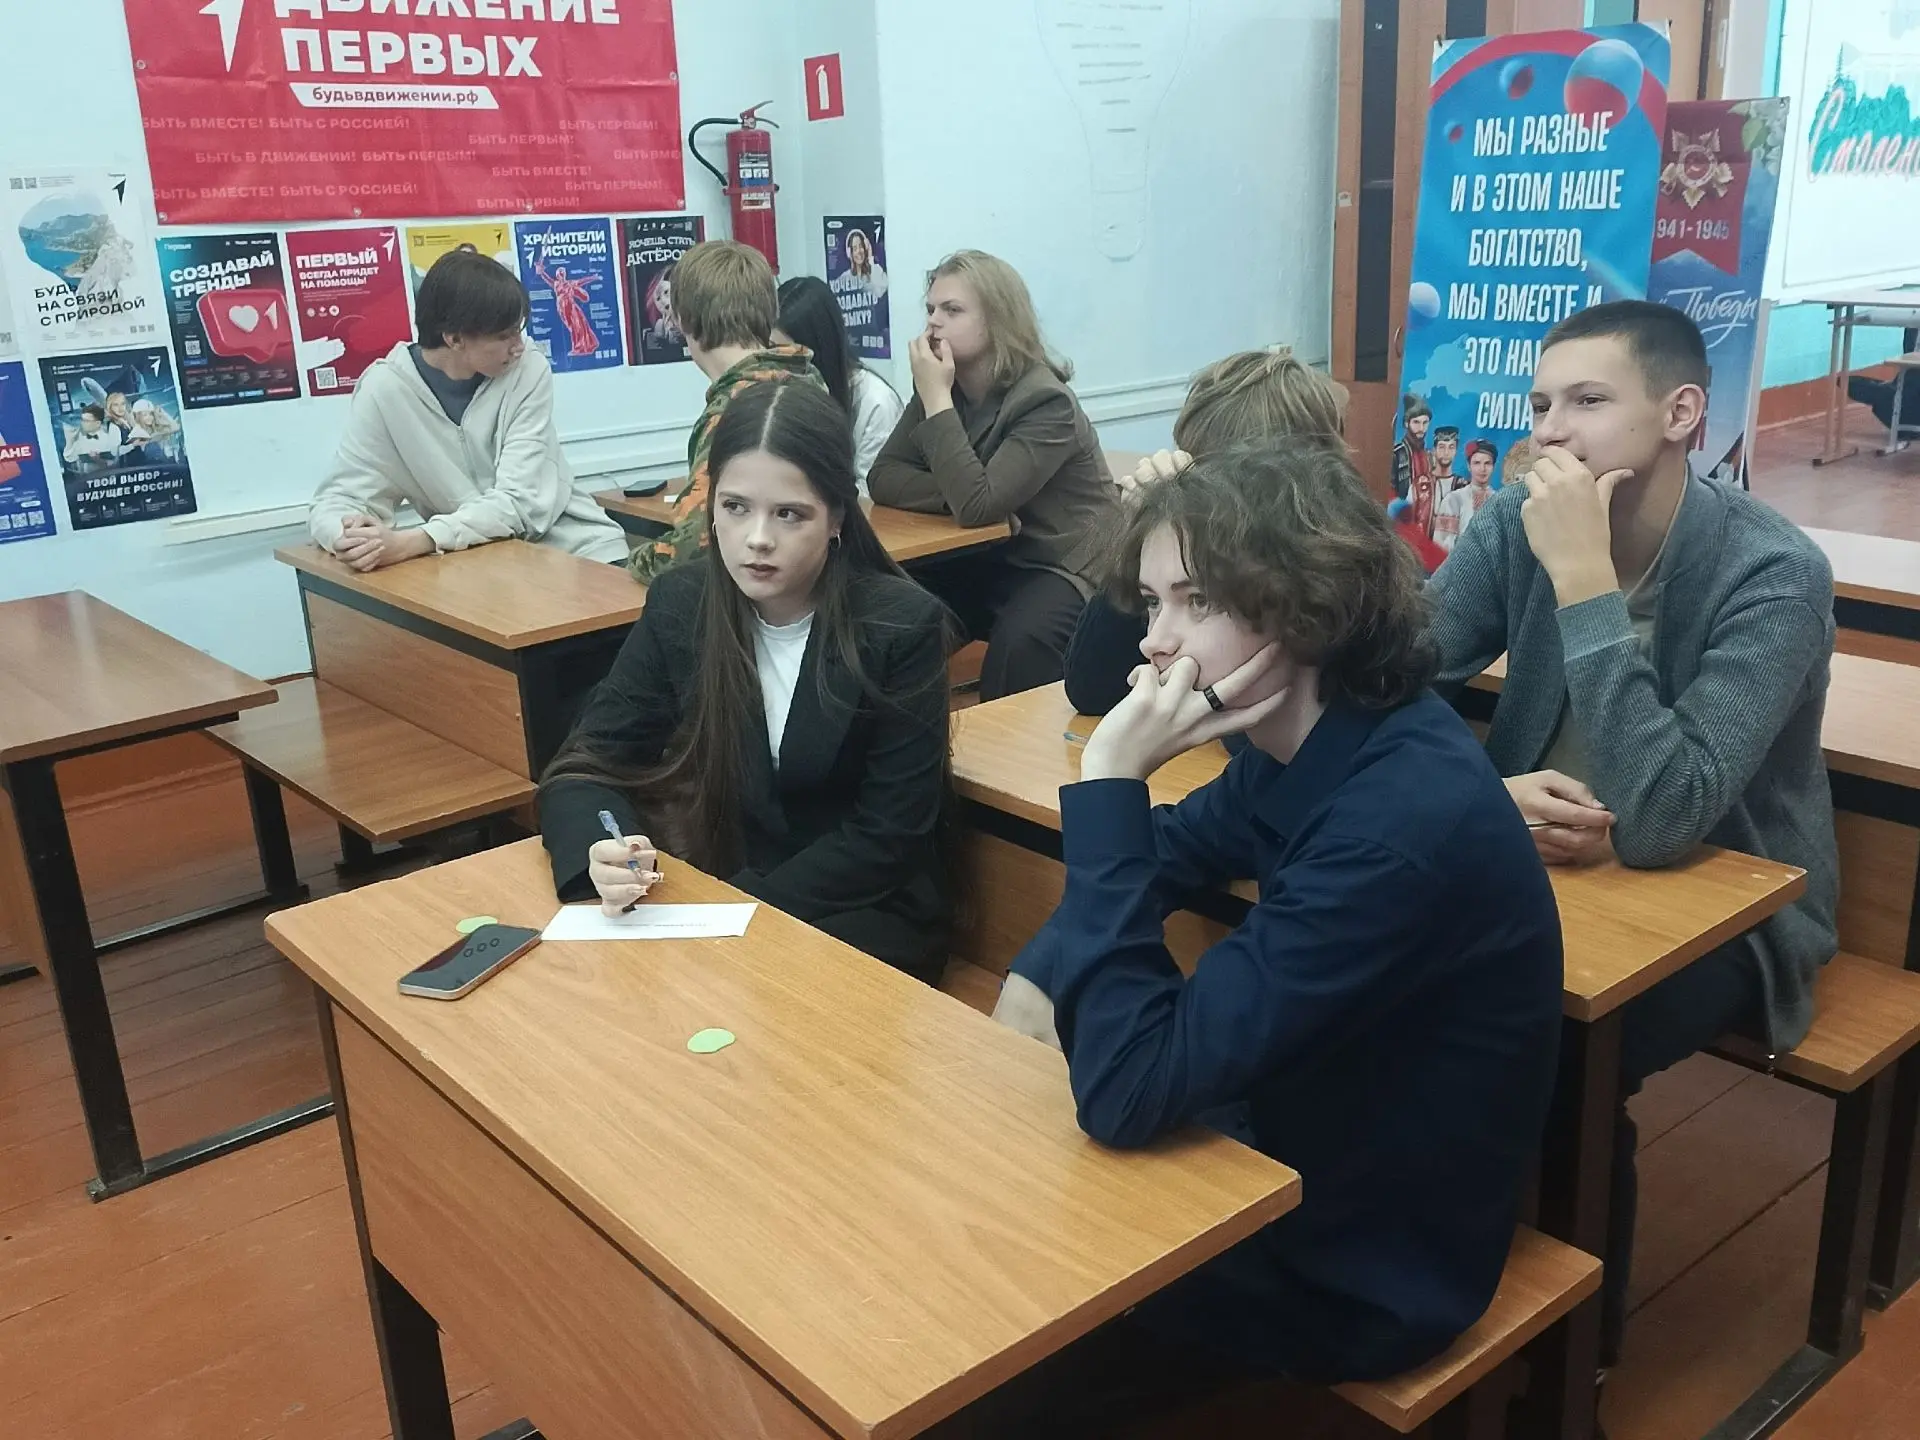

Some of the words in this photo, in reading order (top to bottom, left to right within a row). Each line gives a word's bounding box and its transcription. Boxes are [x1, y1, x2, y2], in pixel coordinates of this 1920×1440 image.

[280, 27, 543, 77] ПЕРВЫХ
[312, 87, 479, 105] будьвдвижении.рф
[190, 118, 263, 129] ВМЕСТЕ!
[269, 118, 314, 129] БЫТЬ
[329, 115, 410, 130] РОССИЕЙ!
[468, 134, 507, 145] БЫТЬ
[1473, 117, 1515, 157] МЫ
[1520, 111, 1614, 155] РАЗНЫЕ
[195, 152, 242, 164] БЫТЬ
[259, 151, 356, 164] ДВИЖЕНИИ!
[362, 150, 406, 162] БЫТЬ
[492, 166, 530, 176] БЫТЬ
[533, 165, 592, 177] ВМЕСТЕ!
[200, 186, 273, 198] ВМЕСТЕ!
[280, 185, 322, 197] БЫТЬ
[338, 183, 418, 197] РОССИЕЙ!
[1450, 174, 1467, 212] И
[1472, 174, 1487, 212] В
[1492, 171, 1553, 212] ЭТОМ
[1558, 169, 1625, 210] НАШЕ
[523, 230, 606, 246] ХРАНИТЕЛИ
[667, 236, 696, 247] СТАТЬ
[296, 247, 378, 269] ПЕРВЫЙ
[542, 243, 607, 258] ИСТОРИИ
[626, 247, 686, 267] АКТЁРО
[1468, 228, 1588, 272] БОГАТСТВО,
[169, 250, 276, 283] СОЗДАВАЙ
[299, 270, 338, 280] ВСЕГДА
[339, 266, 379, 277] ПРИДЕТ
[34, 283, 78, 299] БУДЬ
[171, 272, 252, 299] ТРЕНДЫ
[301, 280, 316, 290] НА
[37, 302, 61, 313] НА
[64, 289, 119, 307] СВЯЗИ
[40, 316, 52, 326] С
[55, 295, 146, 324] ПРИРОДОЙ
[1447, 282, 1489, 321] МЫ
[1493, 283, 1580, 323] ВМЕСТЕ
[1667, 286, 1758, 349] Победы
[1463, 336, 1501, 375] ЭТО
[1476, 391, 1534, 431] СИЛА
[76, 487, 131, 502] БУДУЩЕЕ
[133, 478, 183, 494] РОССИИ!
[86, 475, 117, 489] ТВОЙ
[120, 470, 161, 485] ВЫБОР
